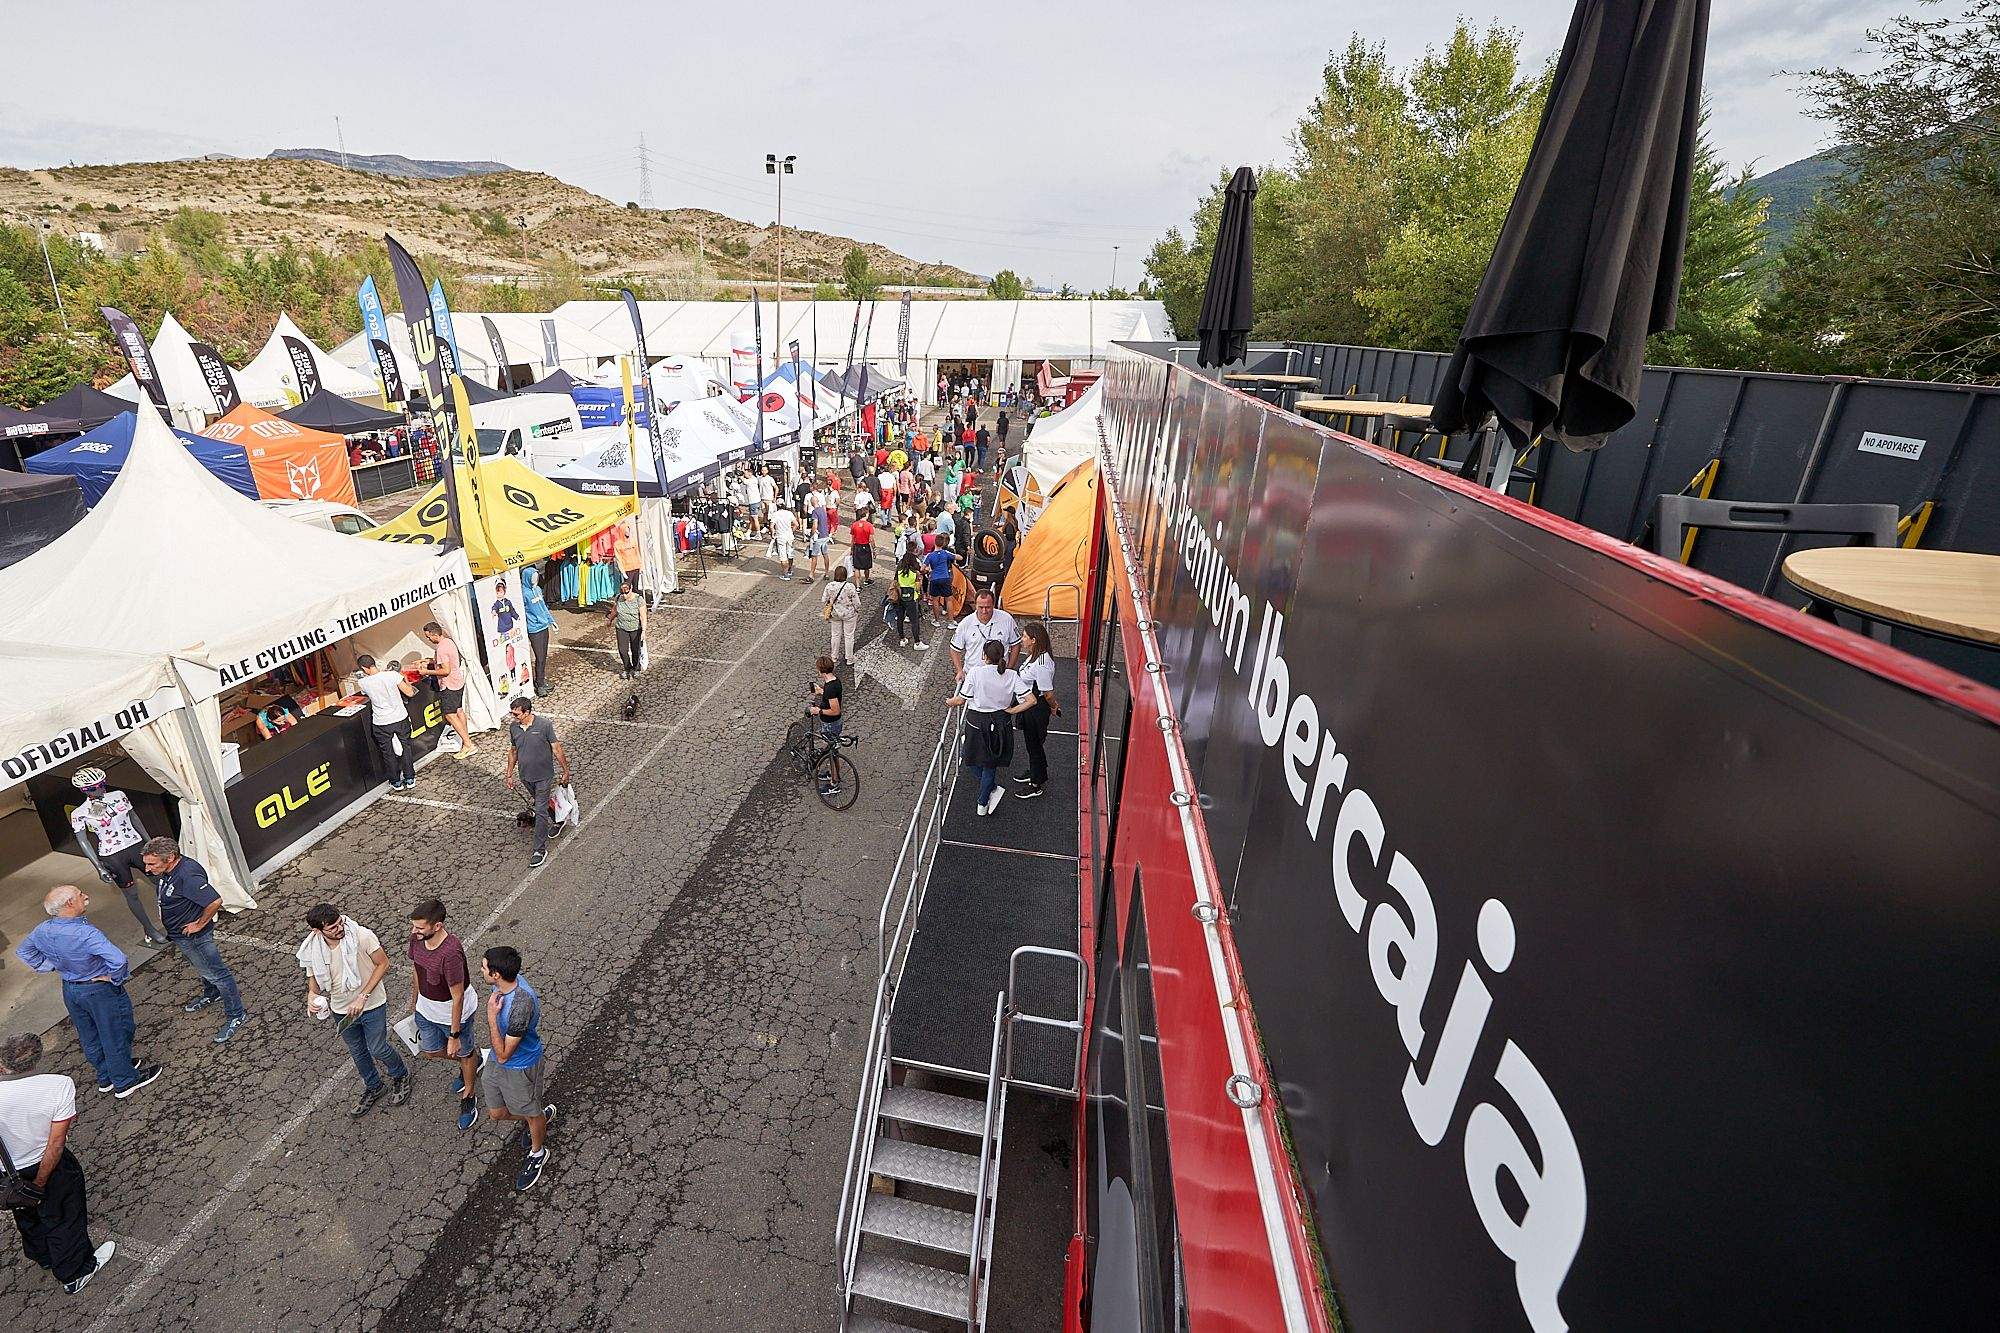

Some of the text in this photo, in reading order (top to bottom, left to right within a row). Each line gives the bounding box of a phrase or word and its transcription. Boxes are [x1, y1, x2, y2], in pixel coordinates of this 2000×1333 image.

[533, 420, 574, 437] enterprise
[1864, 437, 1919, 454] NO APOYARSE
[526, 507, 585, 533] IZAS
[218, 658, 254, 687] ALE
[255, 627, 328, 669] CYCLING
[336, 602, 388, 636] TIENDA
[390, 581, 437, 612] OFICIAL
[438, 572, 457, 590] QH
[1, 700, 150, 780] OFICIAL QH
[1174, 479, 1588, 1333] Premium Ibercaja
